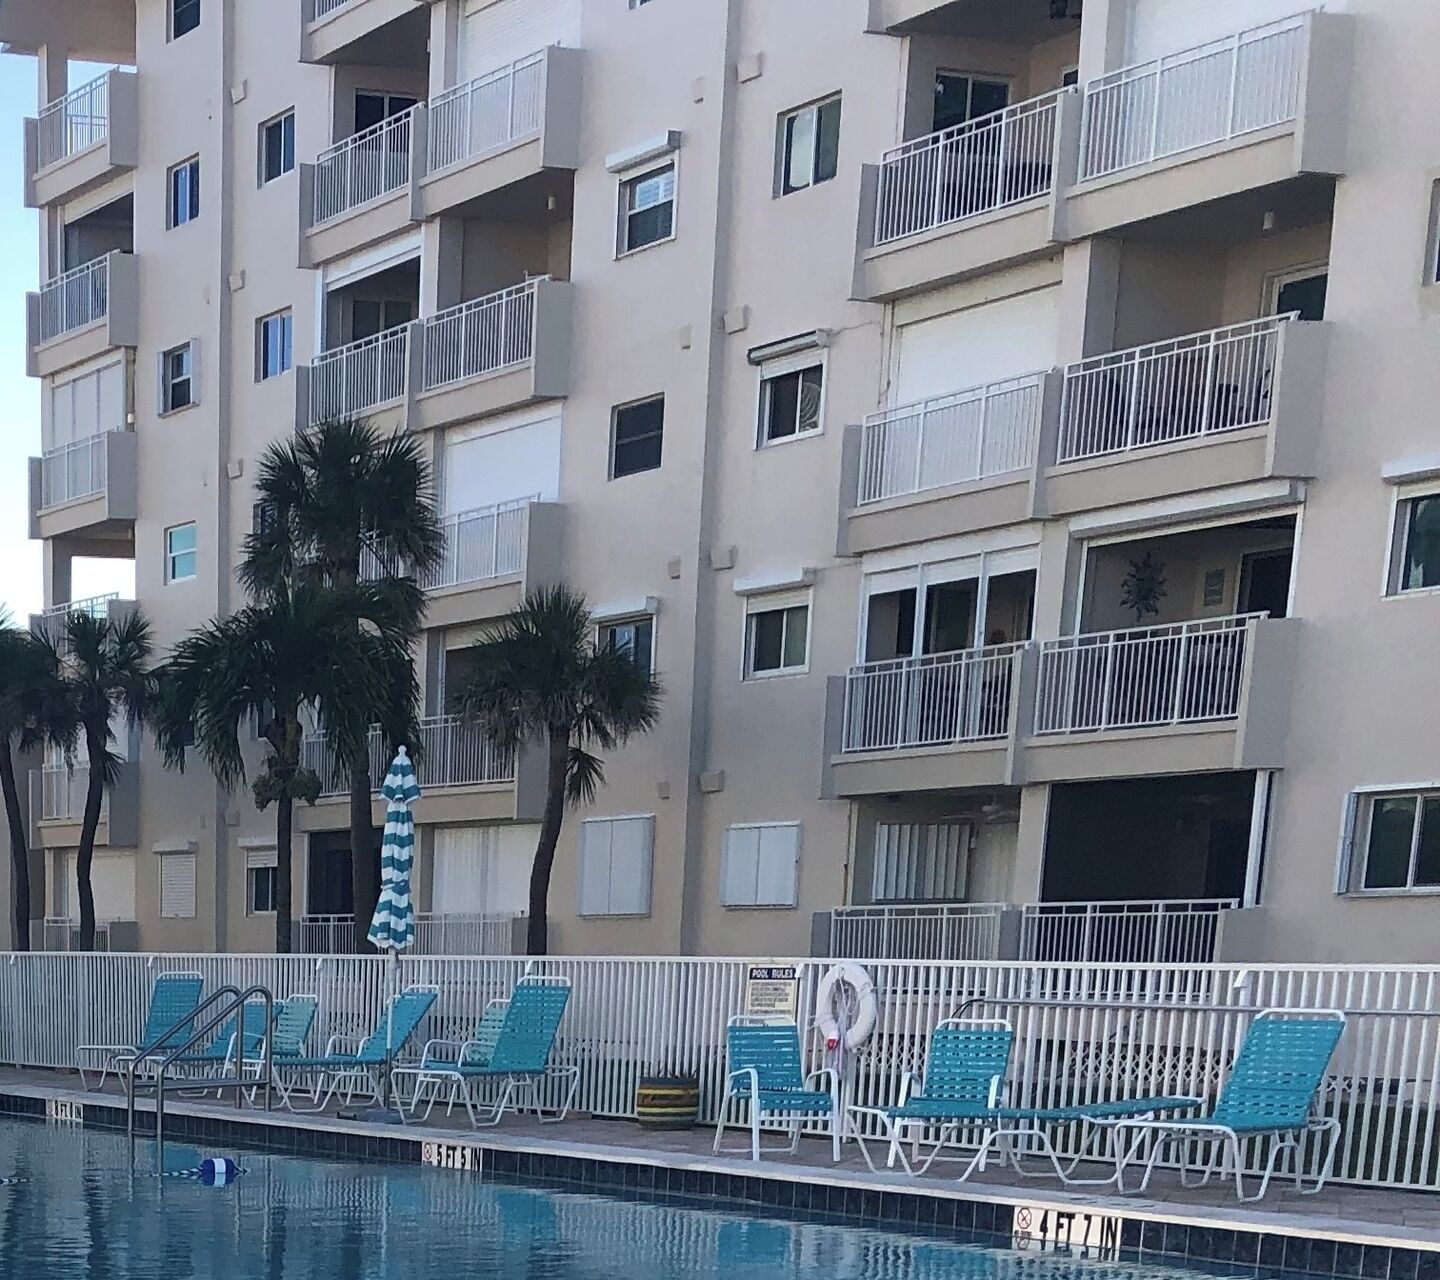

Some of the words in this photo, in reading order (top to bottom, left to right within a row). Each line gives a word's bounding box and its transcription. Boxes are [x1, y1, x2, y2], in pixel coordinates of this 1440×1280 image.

[752, 969, 769, 979] POOL
[771, 969, 793, 979] RULES
[437, 1143, 442, 1167] 5
[446, 1145, 457, 1169] FT
[461, 1146, 466, 1169] 5
[470, 1147, 481, 1171] IN
[1040, 1209, 1048, 1241] 4
[1055, 1211, 1076, 1243] FT
[1083, 1214, 1092, 1246] 7
[1100, 1216, 1119, 1249] IN
